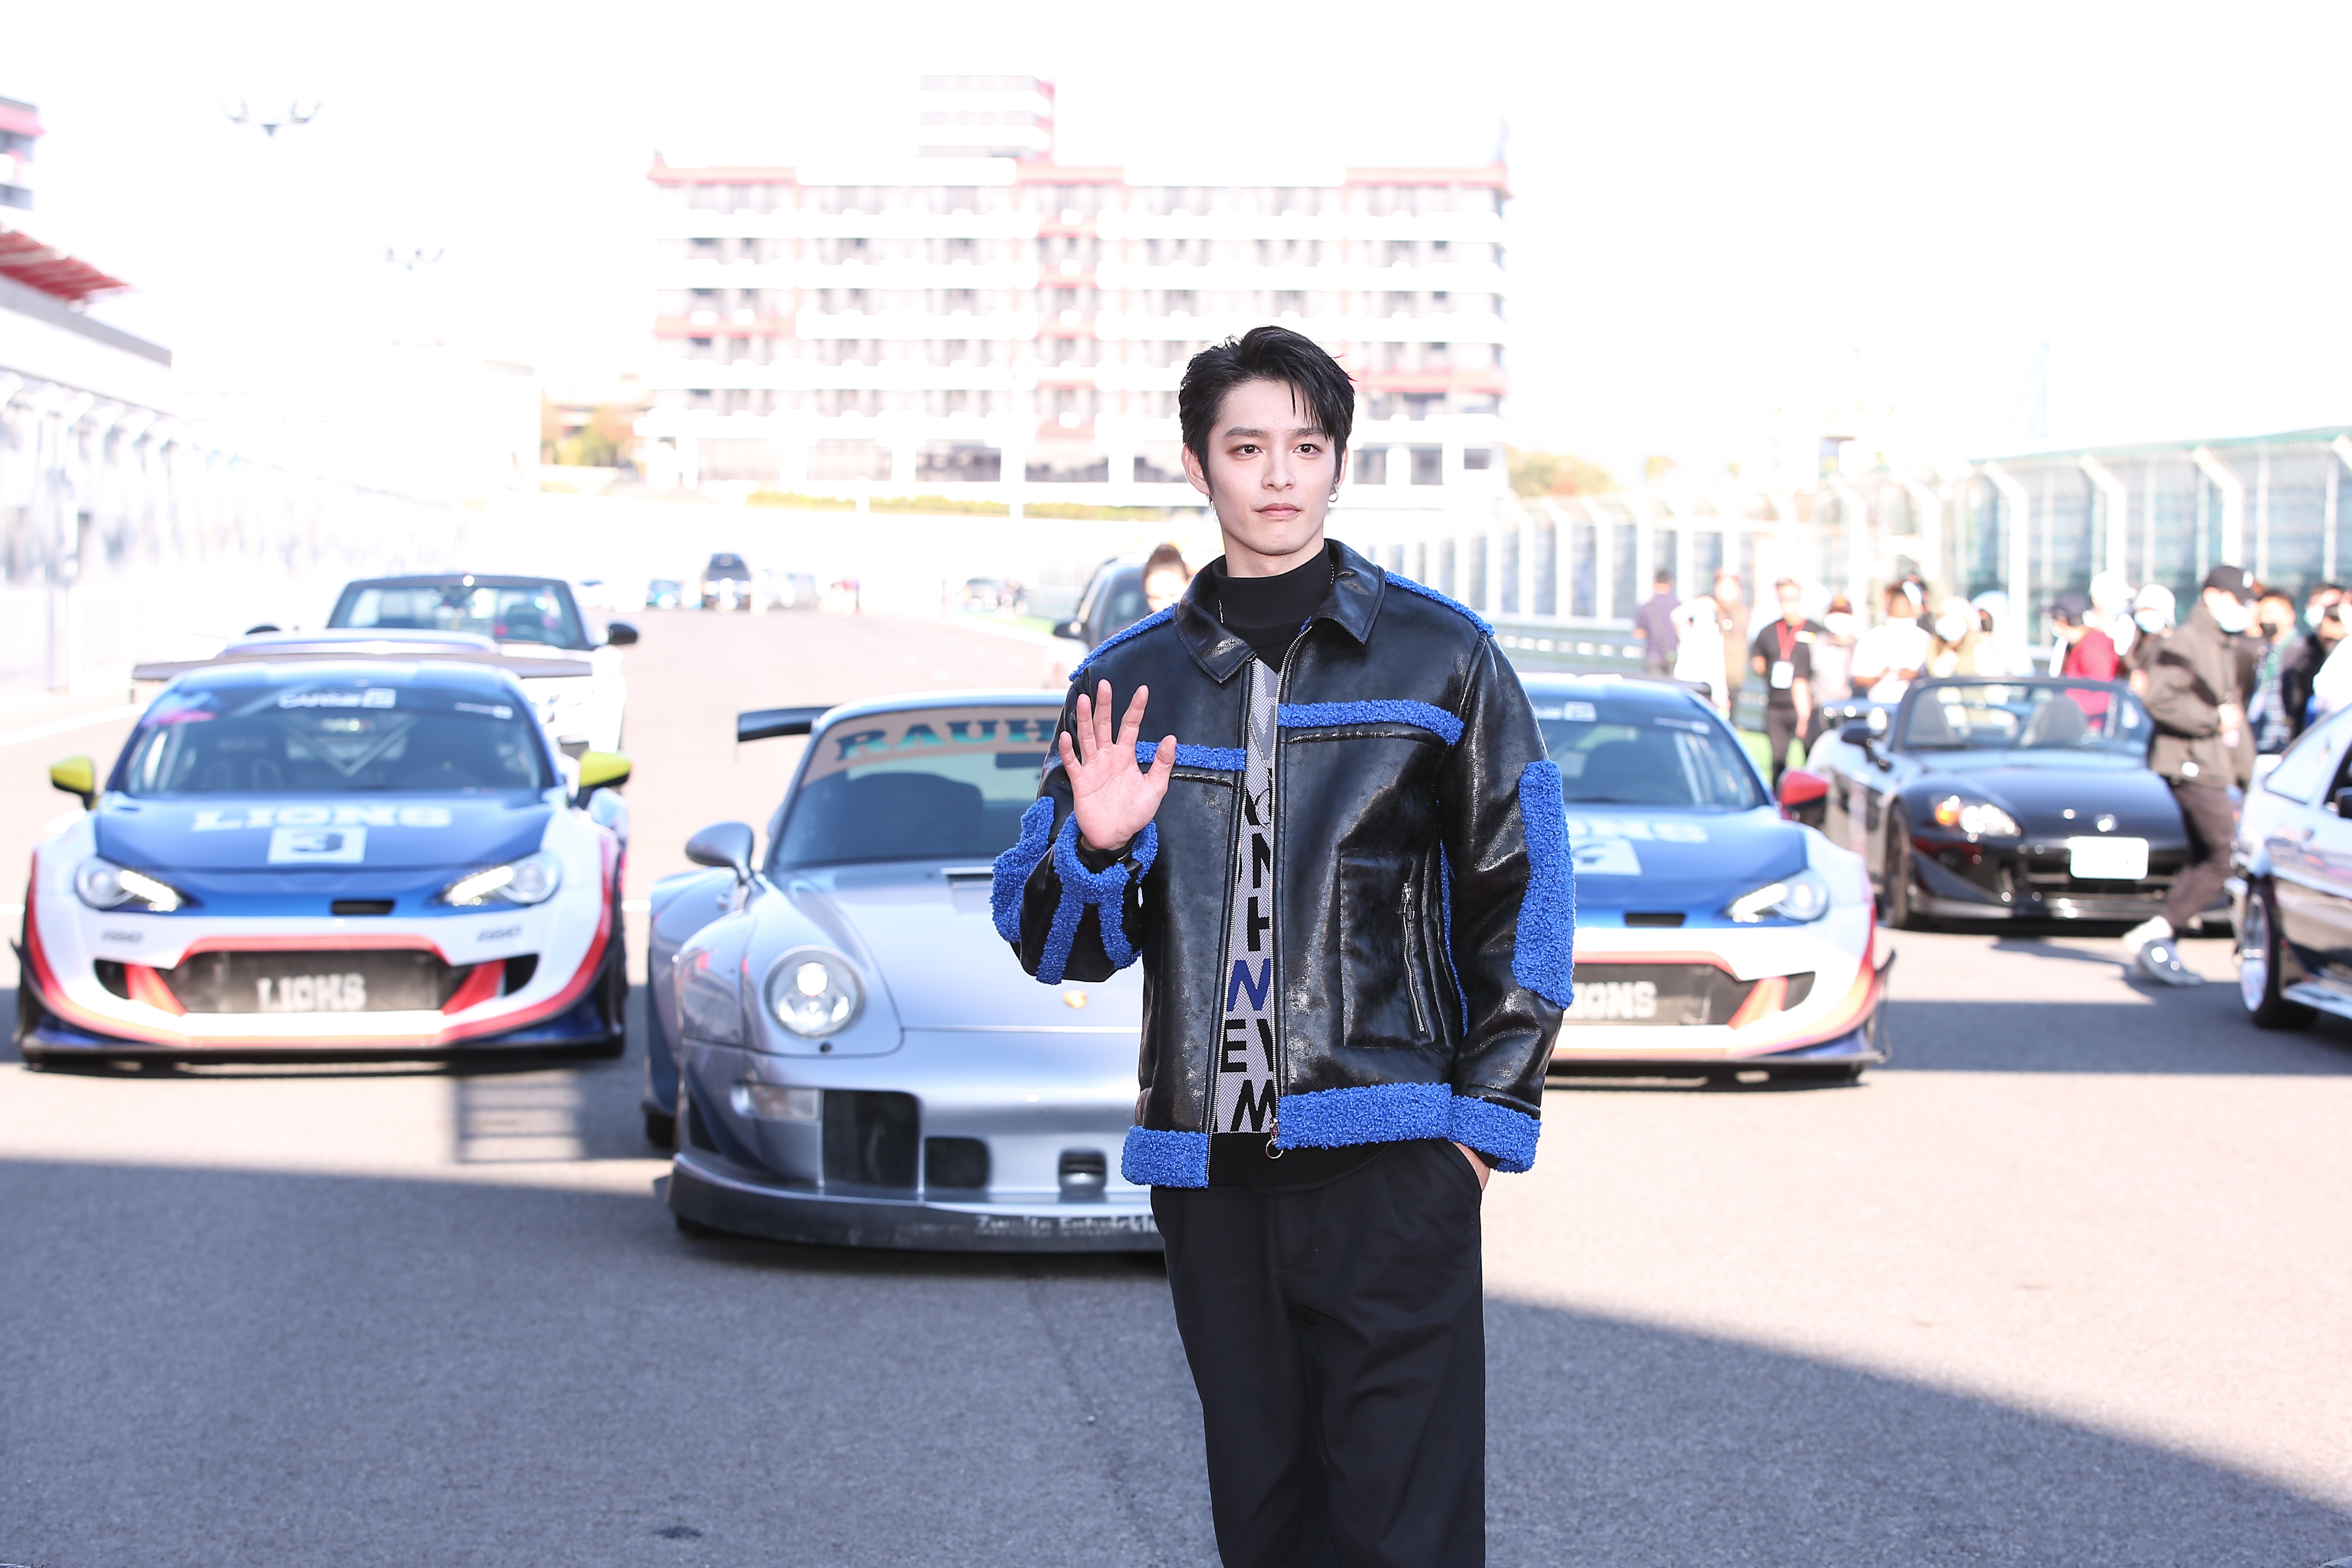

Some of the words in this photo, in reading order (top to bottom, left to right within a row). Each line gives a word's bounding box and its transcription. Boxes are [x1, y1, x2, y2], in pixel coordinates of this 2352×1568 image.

[836, 719, 1058, 762] RAUH
[190, 805, 453, 832] LIONS
[289, 832, 344, 852] 3
[256, 972, 367, 1013] LIONS
[1564, 981, 1658, 1020] IONS
